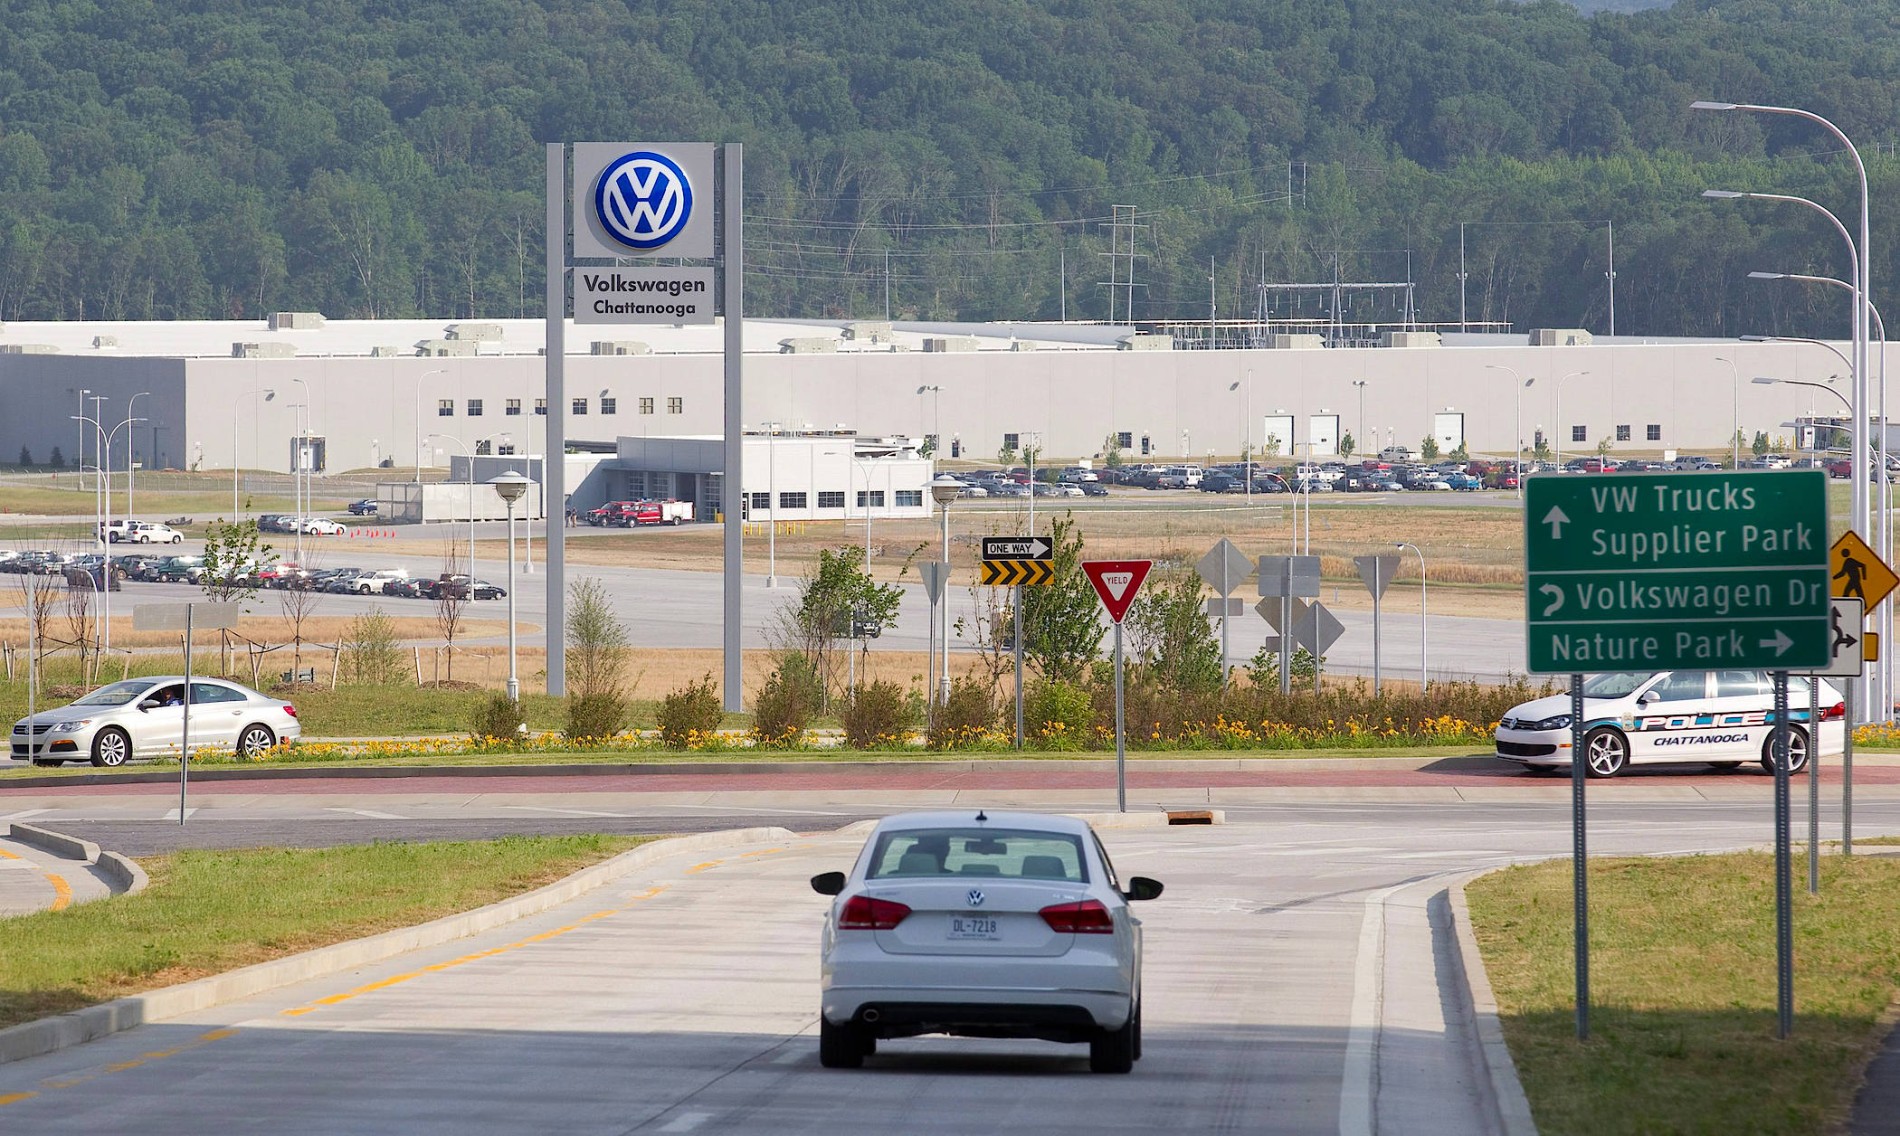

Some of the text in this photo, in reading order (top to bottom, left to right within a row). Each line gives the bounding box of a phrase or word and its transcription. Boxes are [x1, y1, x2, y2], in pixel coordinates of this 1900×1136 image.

[603, 159, 684, 240] VW
[584, 274, 705, 296] Volkswagen
[593, 300, 696, 317] Chattanooga
[1592, 482, 1756, 513] VW Trucks
[990, 543, 1032, 554] ONE WAY
[1592, 522, 1812, 562] Supplier Park
[1577, 580, 1821, 614] Volkswagen Dr
[1552, 629, 1745, 661] Nature Park
[1640, 711, 1767, 731] POLICE
[1653, 733, 1749, 746] CHATTANOOGA
[953, 919, 997, 933] DL-7218
